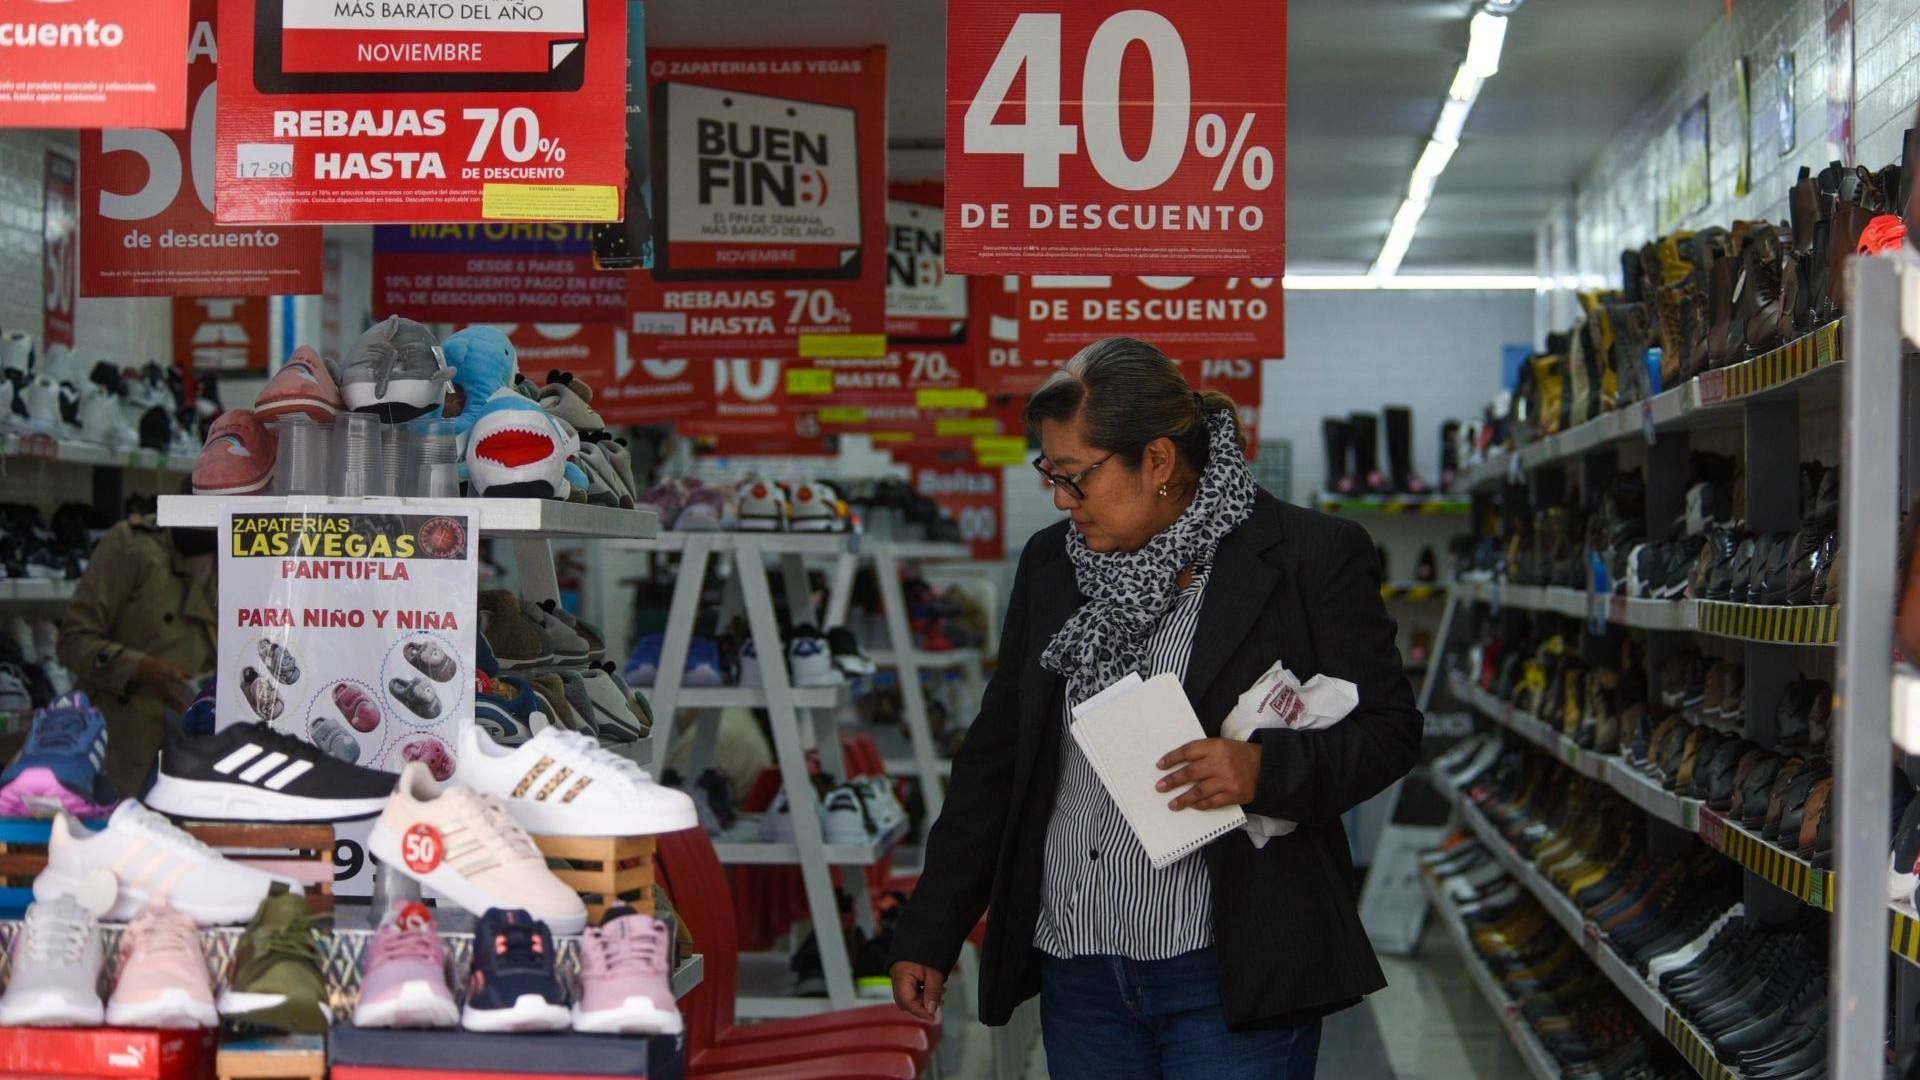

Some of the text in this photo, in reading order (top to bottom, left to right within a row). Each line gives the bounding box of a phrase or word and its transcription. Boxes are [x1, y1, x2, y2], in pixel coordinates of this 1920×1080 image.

[334, 0, 544, 20] MÁS BARATO DEL AÑO
[358, 43, 482, 62] NOVIEMBRE
[771, 61, 802, 74] LAS
[805, 60, 862, 73] VEGAS
[963, 9, 1274, 191] 40%
[273, 107, 566, 162] REBAJAS 70%
[697, 118, 829, 166] BUEN
[239, 152, 447, 180] 17-20 HASTA
[462, 168, 565, 179] DE DESCUENTO
[961, 204, 1265, 232] DE DESCUENTO
[123, 229, 279, 249] de descuento
[467, 259, 512, 272] DESDE
[528, 259, 575, 272] PARES
[715, 250, 797, 262] NOVIEMBRE
[414, 276, 433, 290] DE
[436, 275, 522, 290] DESCUENTO
[524, 276, 563, 290] PAGO
[566, 276, 585, 290] EN
[409, 292, 428, 306] DE
[431, 292, 515, 306] DESCUENTO
[519, 292, 557, 307] PAGO
[560, 292, 591, 307] CON
[663, 289, 851, 325] REBAJAS 70%
[1029, 299, 1269, 321] DE DESCUENTO
[690, 317, 775, 335] HASTA
[233, 515, 350, 533] ZAPATERÍAS
[233, 533, 416, 557] LAS VEGAS
[282, 560, 410, 581] PANTUFLA
[237, 608, 296, 627] PARA
[373, 609, 390, 629] Y
[405, 835, 435, 862] 50
